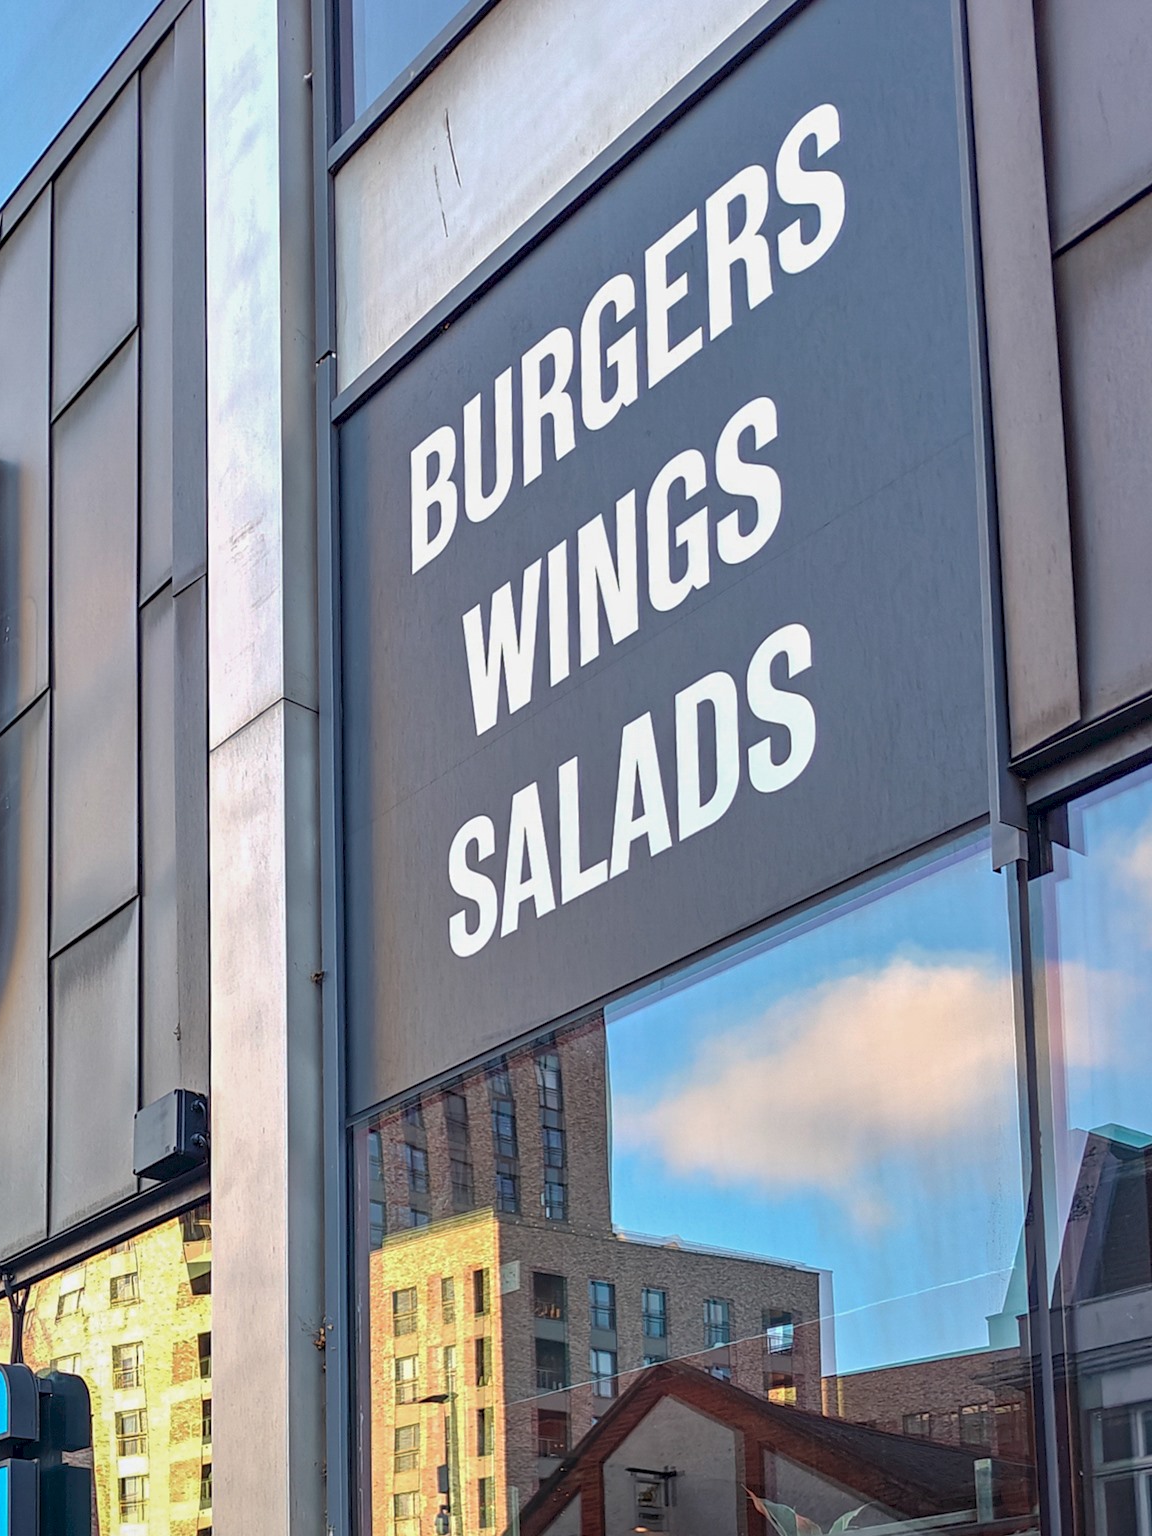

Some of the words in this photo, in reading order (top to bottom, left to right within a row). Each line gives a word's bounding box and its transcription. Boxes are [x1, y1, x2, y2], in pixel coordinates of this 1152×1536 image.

[409, 103, 847, 575] BURGERS
[462, 396, 783, 736] WINGS
[448, 622, 818, 959] SALADS
